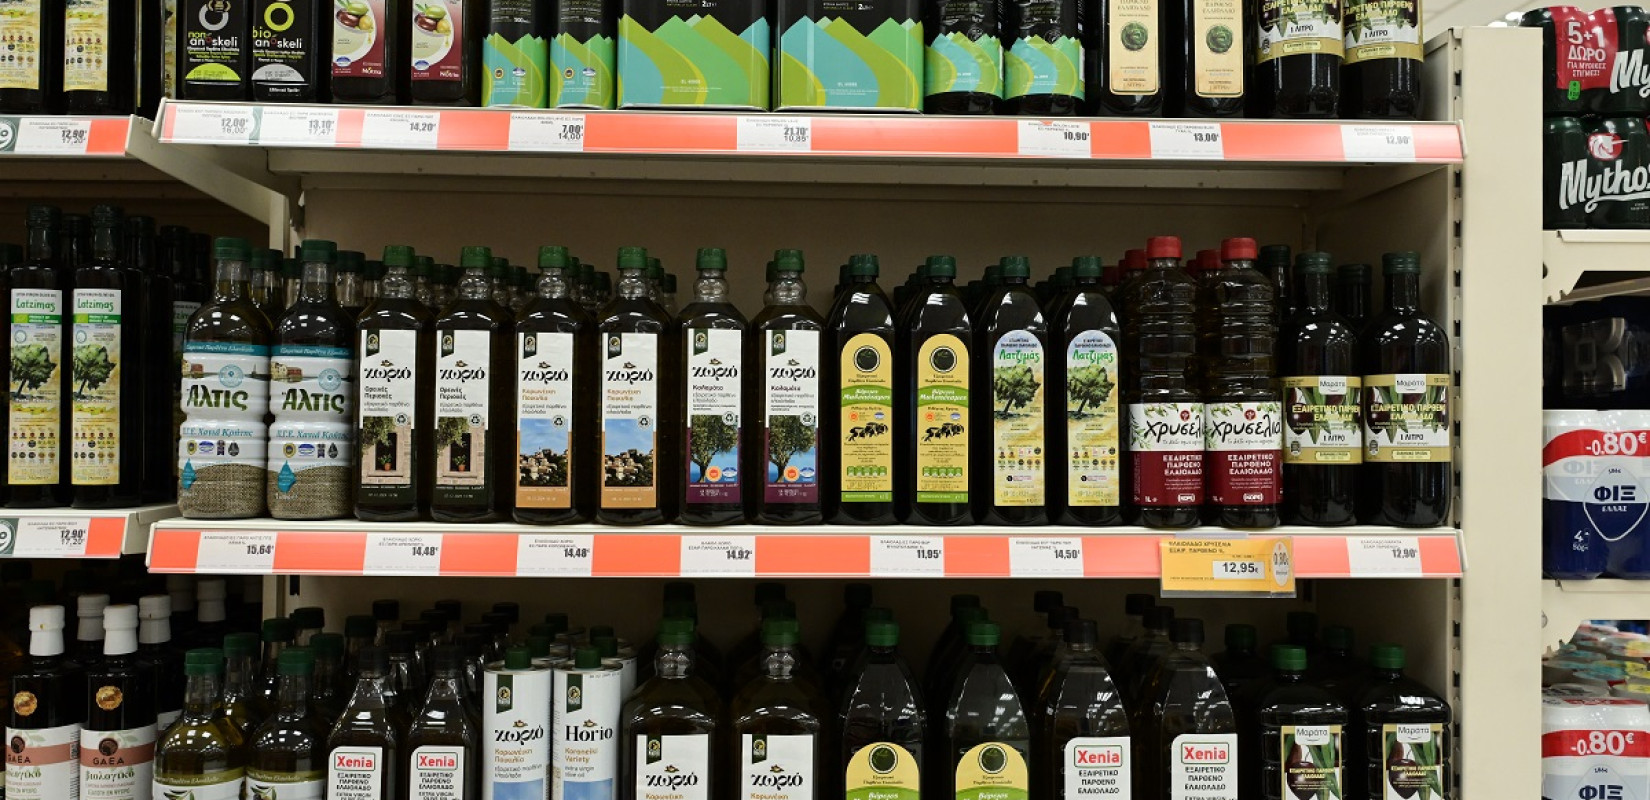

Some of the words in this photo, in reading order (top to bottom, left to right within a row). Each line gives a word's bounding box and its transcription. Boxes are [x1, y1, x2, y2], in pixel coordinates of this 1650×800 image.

[253, 26, 272, 38] bio
[1568, 21, 1605, 48] 5+1
[1568, 46, 1606, 62] ΔΩΡΟ
[1559, 159, 1650, 213] Mytho
[16, 298, 56, 312] Latzimas
[77, 298, 114, 312] Latzimas
[999, 349, 1041, 364] Λατζιμάς
[1072, 349, 1115, 364] Λατζιμάς
[1229, 467, 1273, 475] ΕΛΑΙΟΛΑΔΟ
[1594, 485, 1636, 502] ΦΙΞ
[1223, 562, 1259, 575] 12,95€
[494, 725, 544, 745] χωριό
[565, 725, 613, 742] Horio
[1077, 750, 1120, 764] Xenia
[1184, 746, 1227, 760] Xenia
[92, 757, 125, 765] GAEA
[336, 755, 373, 768] Xenia
[419, 755, 455, 767] Xenia
[1079, 769, 1119, 777] ΕΞΑΙΡΕΤΙΚΟ
[1187, 774, 1223, 782] ΠΑΡΘΕΝΟ
[646, 772, 698, 790] χωριό
[751, 772, 803, 790] χωριό
[1081, 778, 1116, 786] ΠΑΡΘΕΝΟ
